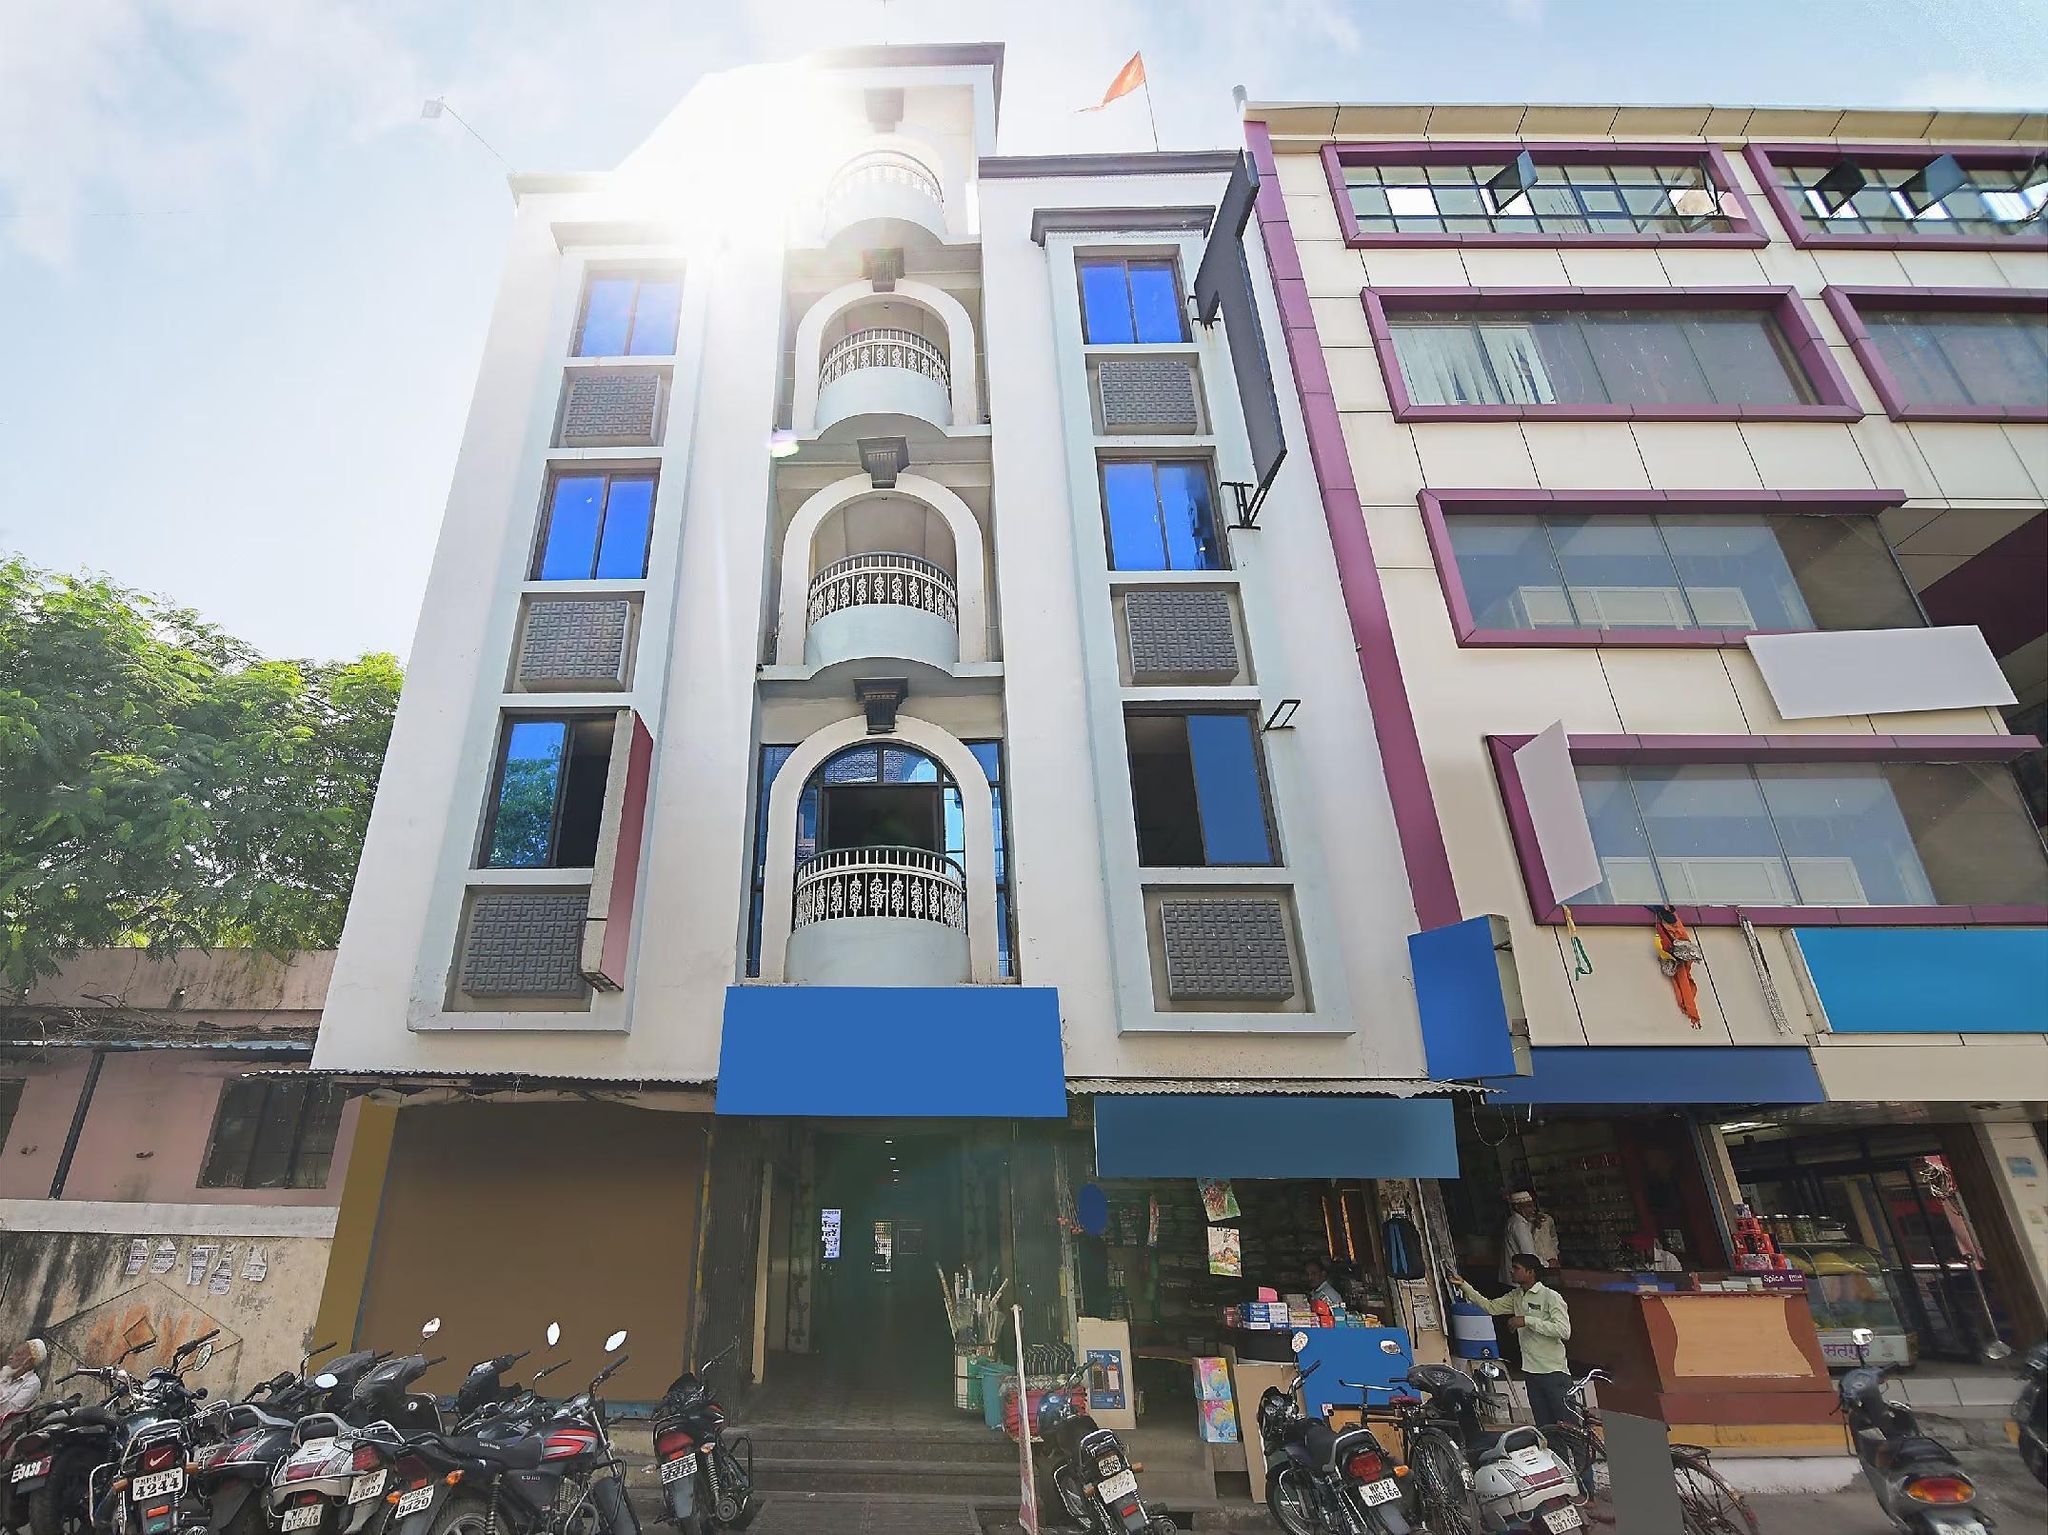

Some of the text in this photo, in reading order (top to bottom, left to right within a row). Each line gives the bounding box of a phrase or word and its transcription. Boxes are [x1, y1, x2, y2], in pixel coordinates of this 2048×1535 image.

[1763, 1274, 1784, 1284] Spice
[135, 1477, 180, 1498] 4244
[399, 1496, 430, 1515] 9429
